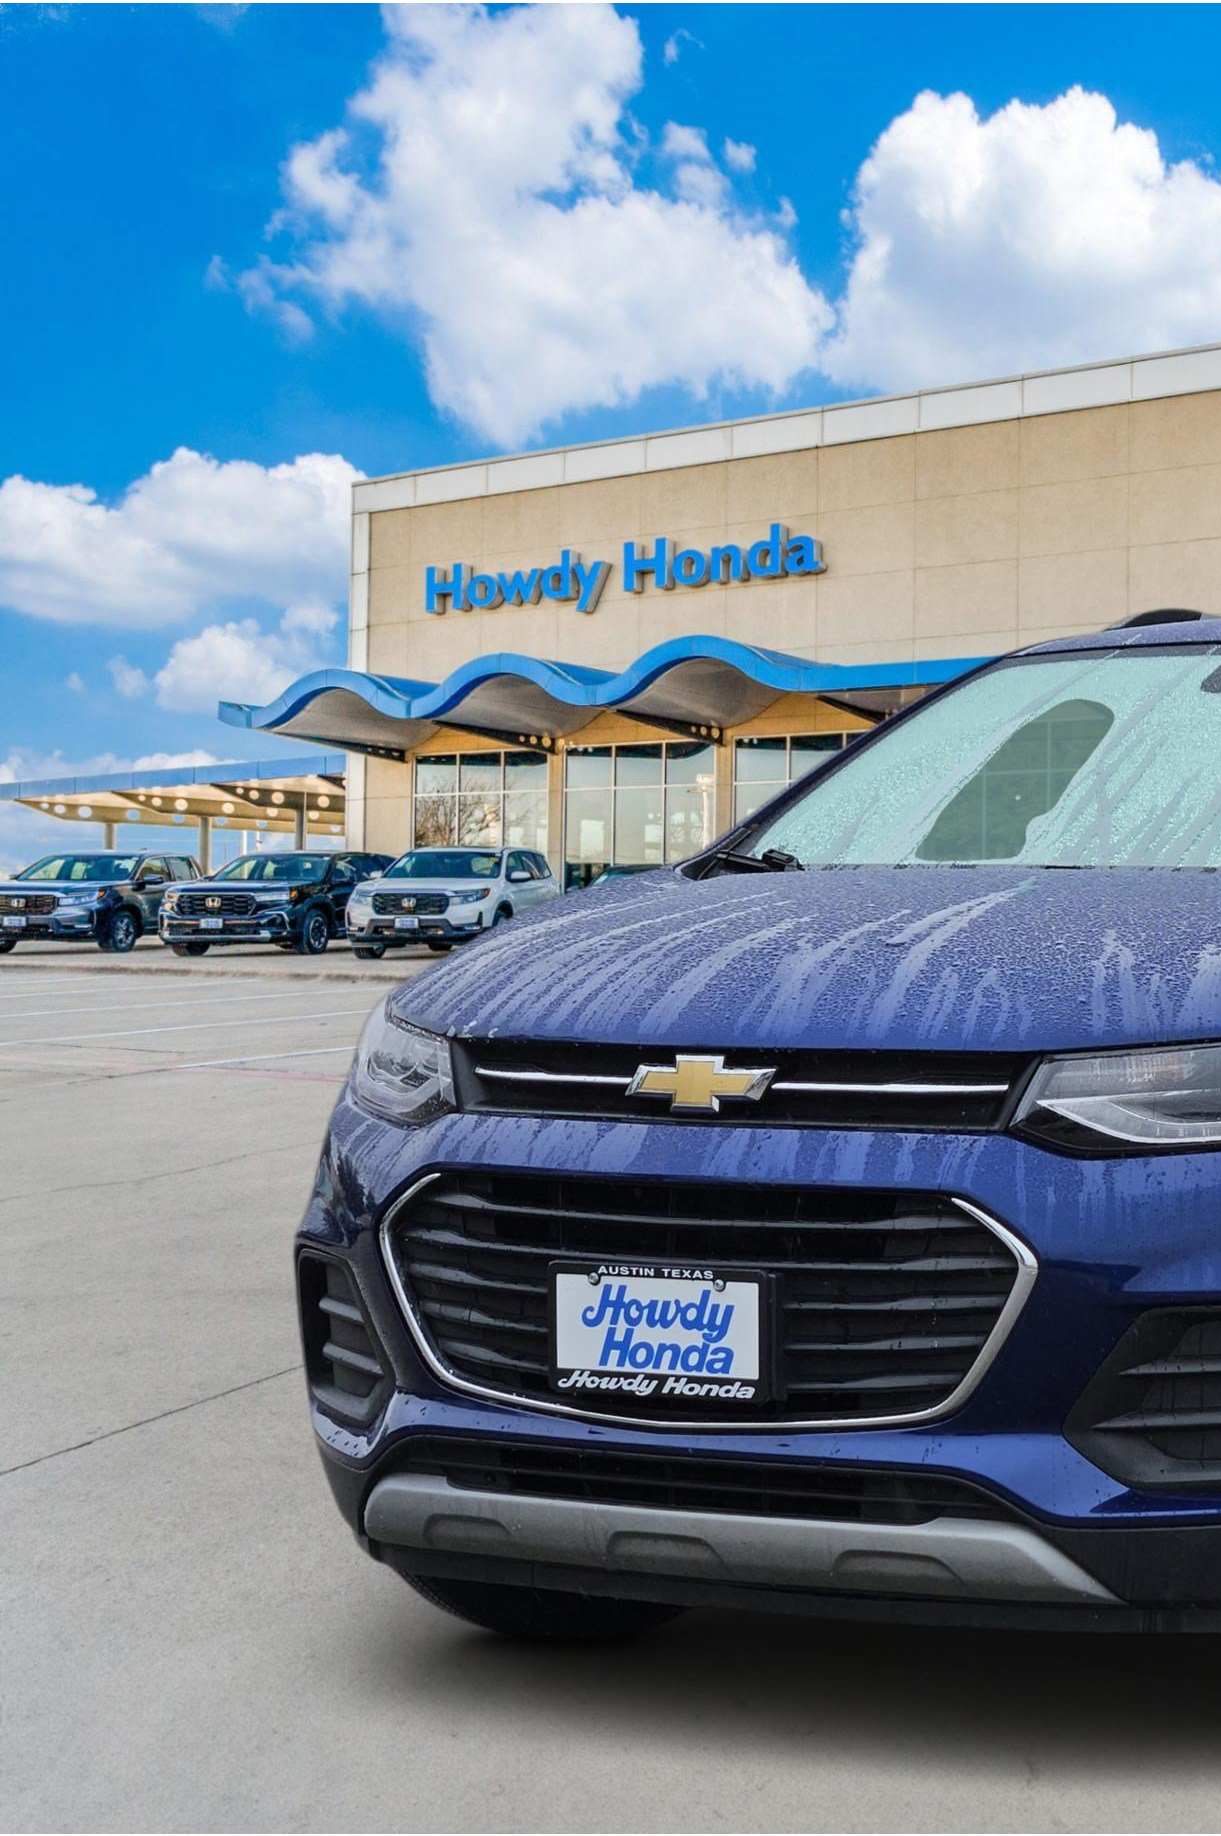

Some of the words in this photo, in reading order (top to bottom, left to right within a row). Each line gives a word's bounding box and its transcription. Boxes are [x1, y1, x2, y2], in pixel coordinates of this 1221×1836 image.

[425, 548, 612, 614] Howdy
[623, 523, 826, 594] Honda
[598, 1265, 655, 1277] AUSTIN
[661, 1268, 714, 1280] TEXAS
[581, 1283, 735, 1344] Howdy
[599, 1327, 735, 1375] Honda
[558, 1370, 659, 1397] Howdy
[661, 1377, 756, 1399] Honda
